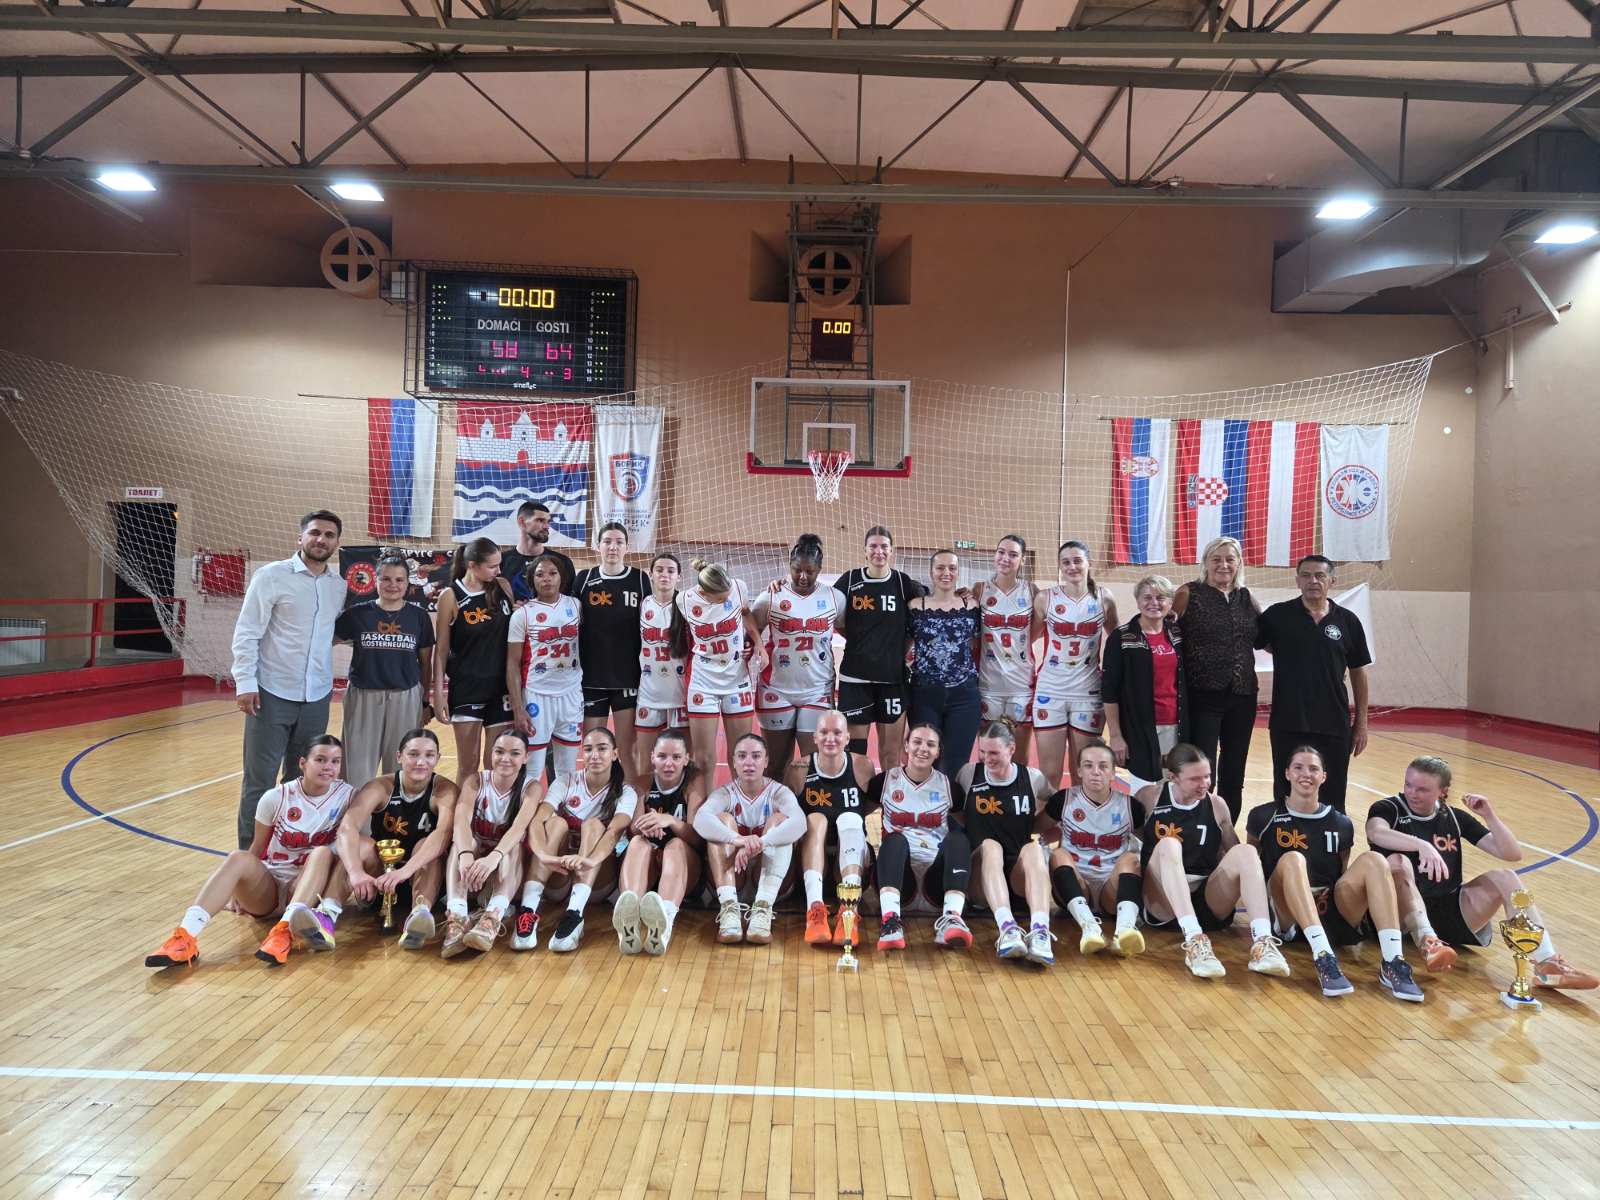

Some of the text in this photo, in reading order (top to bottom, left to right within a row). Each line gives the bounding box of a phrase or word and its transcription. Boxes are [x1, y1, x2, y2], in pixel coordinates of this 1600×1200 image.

[498, 287, 554, 308] 00.00
[536, 321, 569, 333] GOSTI
[822, 321, 851, 334] 0.00
[622, 590, 638, 608] 16
[880, 595, 896, 612] 15
[550, 643, 570, 659] 34
[1069, 641, 1081, 657] 3
[884, 698, 902, 716] 15
[805, 787, 860, 808] bk 13
[975, 794, 1030, 816] bk 14
[417, 812, 432, 833] 4
[1196, 825, 1208, 846] 7
[1276, 826, 1340, 853] bk 11
